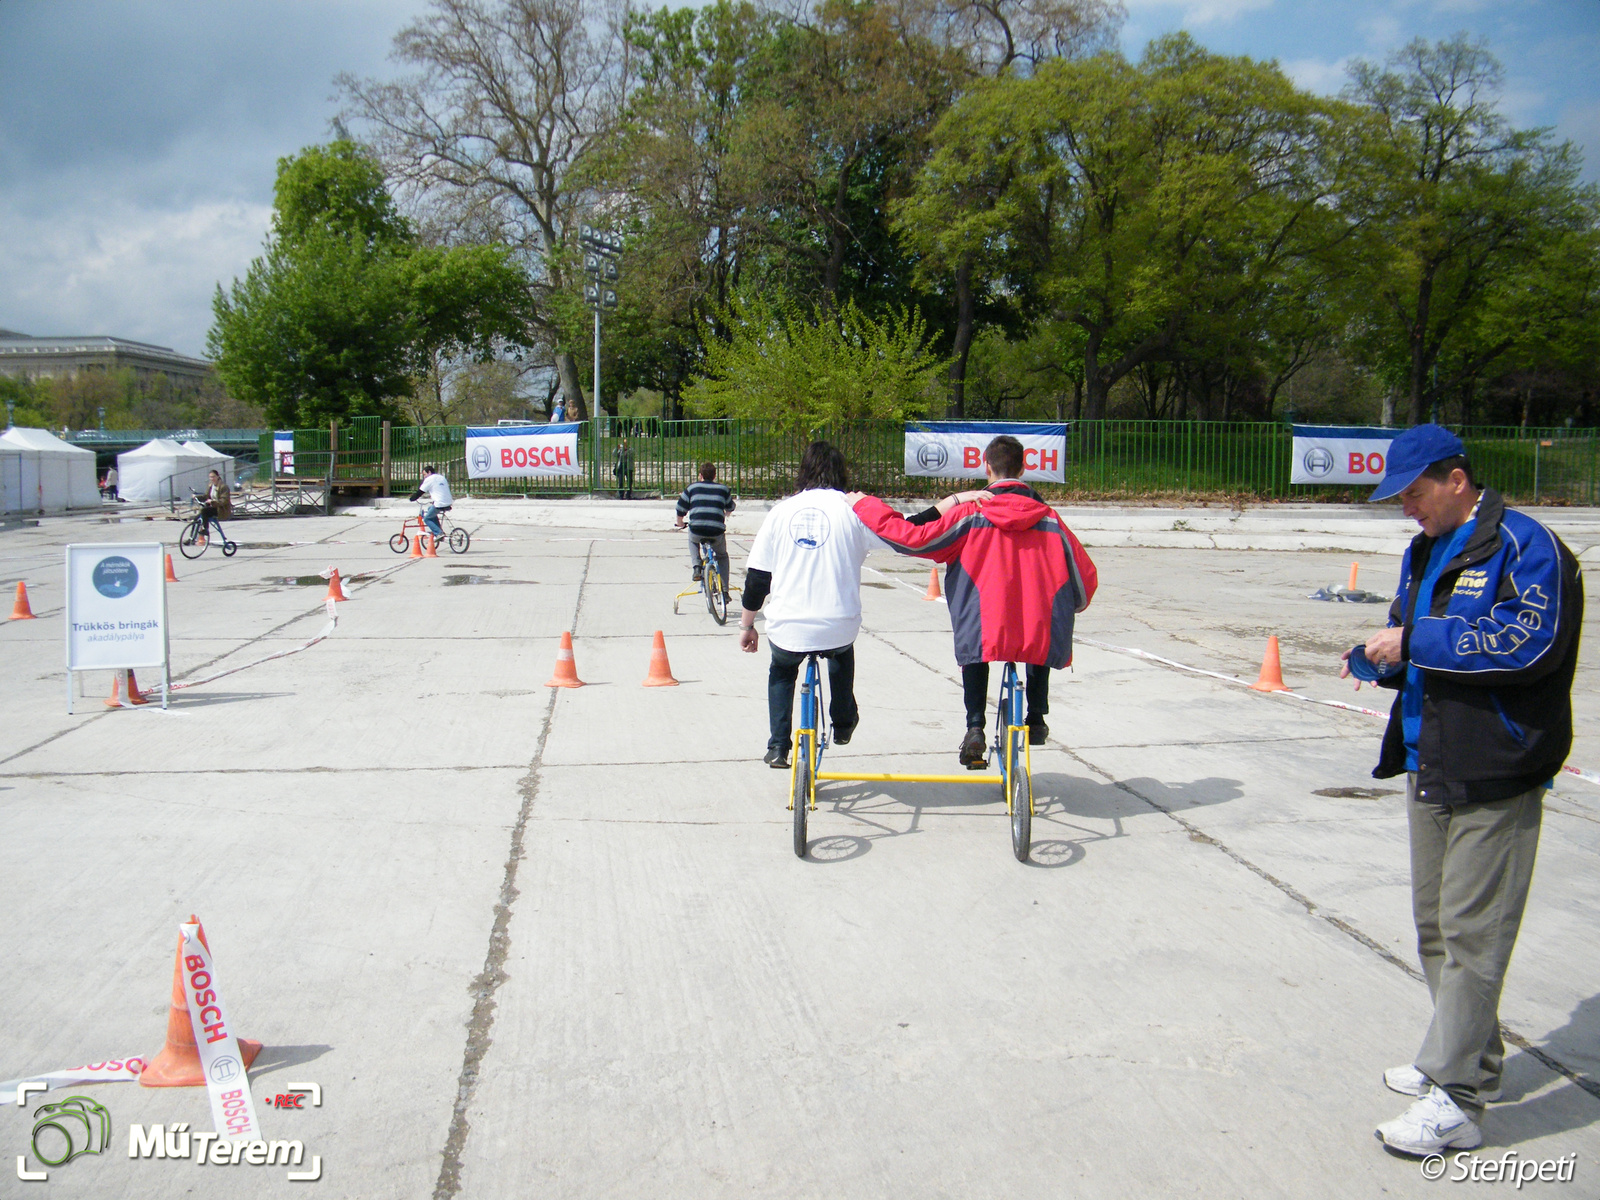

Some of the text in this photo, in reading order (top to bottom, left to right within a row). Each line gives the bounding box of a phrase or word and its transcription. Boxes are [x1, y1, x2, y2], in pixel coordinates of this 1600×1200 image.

[500, 446, 571, 468] BOSCH
[963, 446, 1059, 472] BCH
[72, 619, 159, 632] Trükkös bringák
[87, 632, 145, 643] akadálypálya
[184, 954, 229, 1045] BOSCH
[221, 1088, 252, 1137] BOSCH
